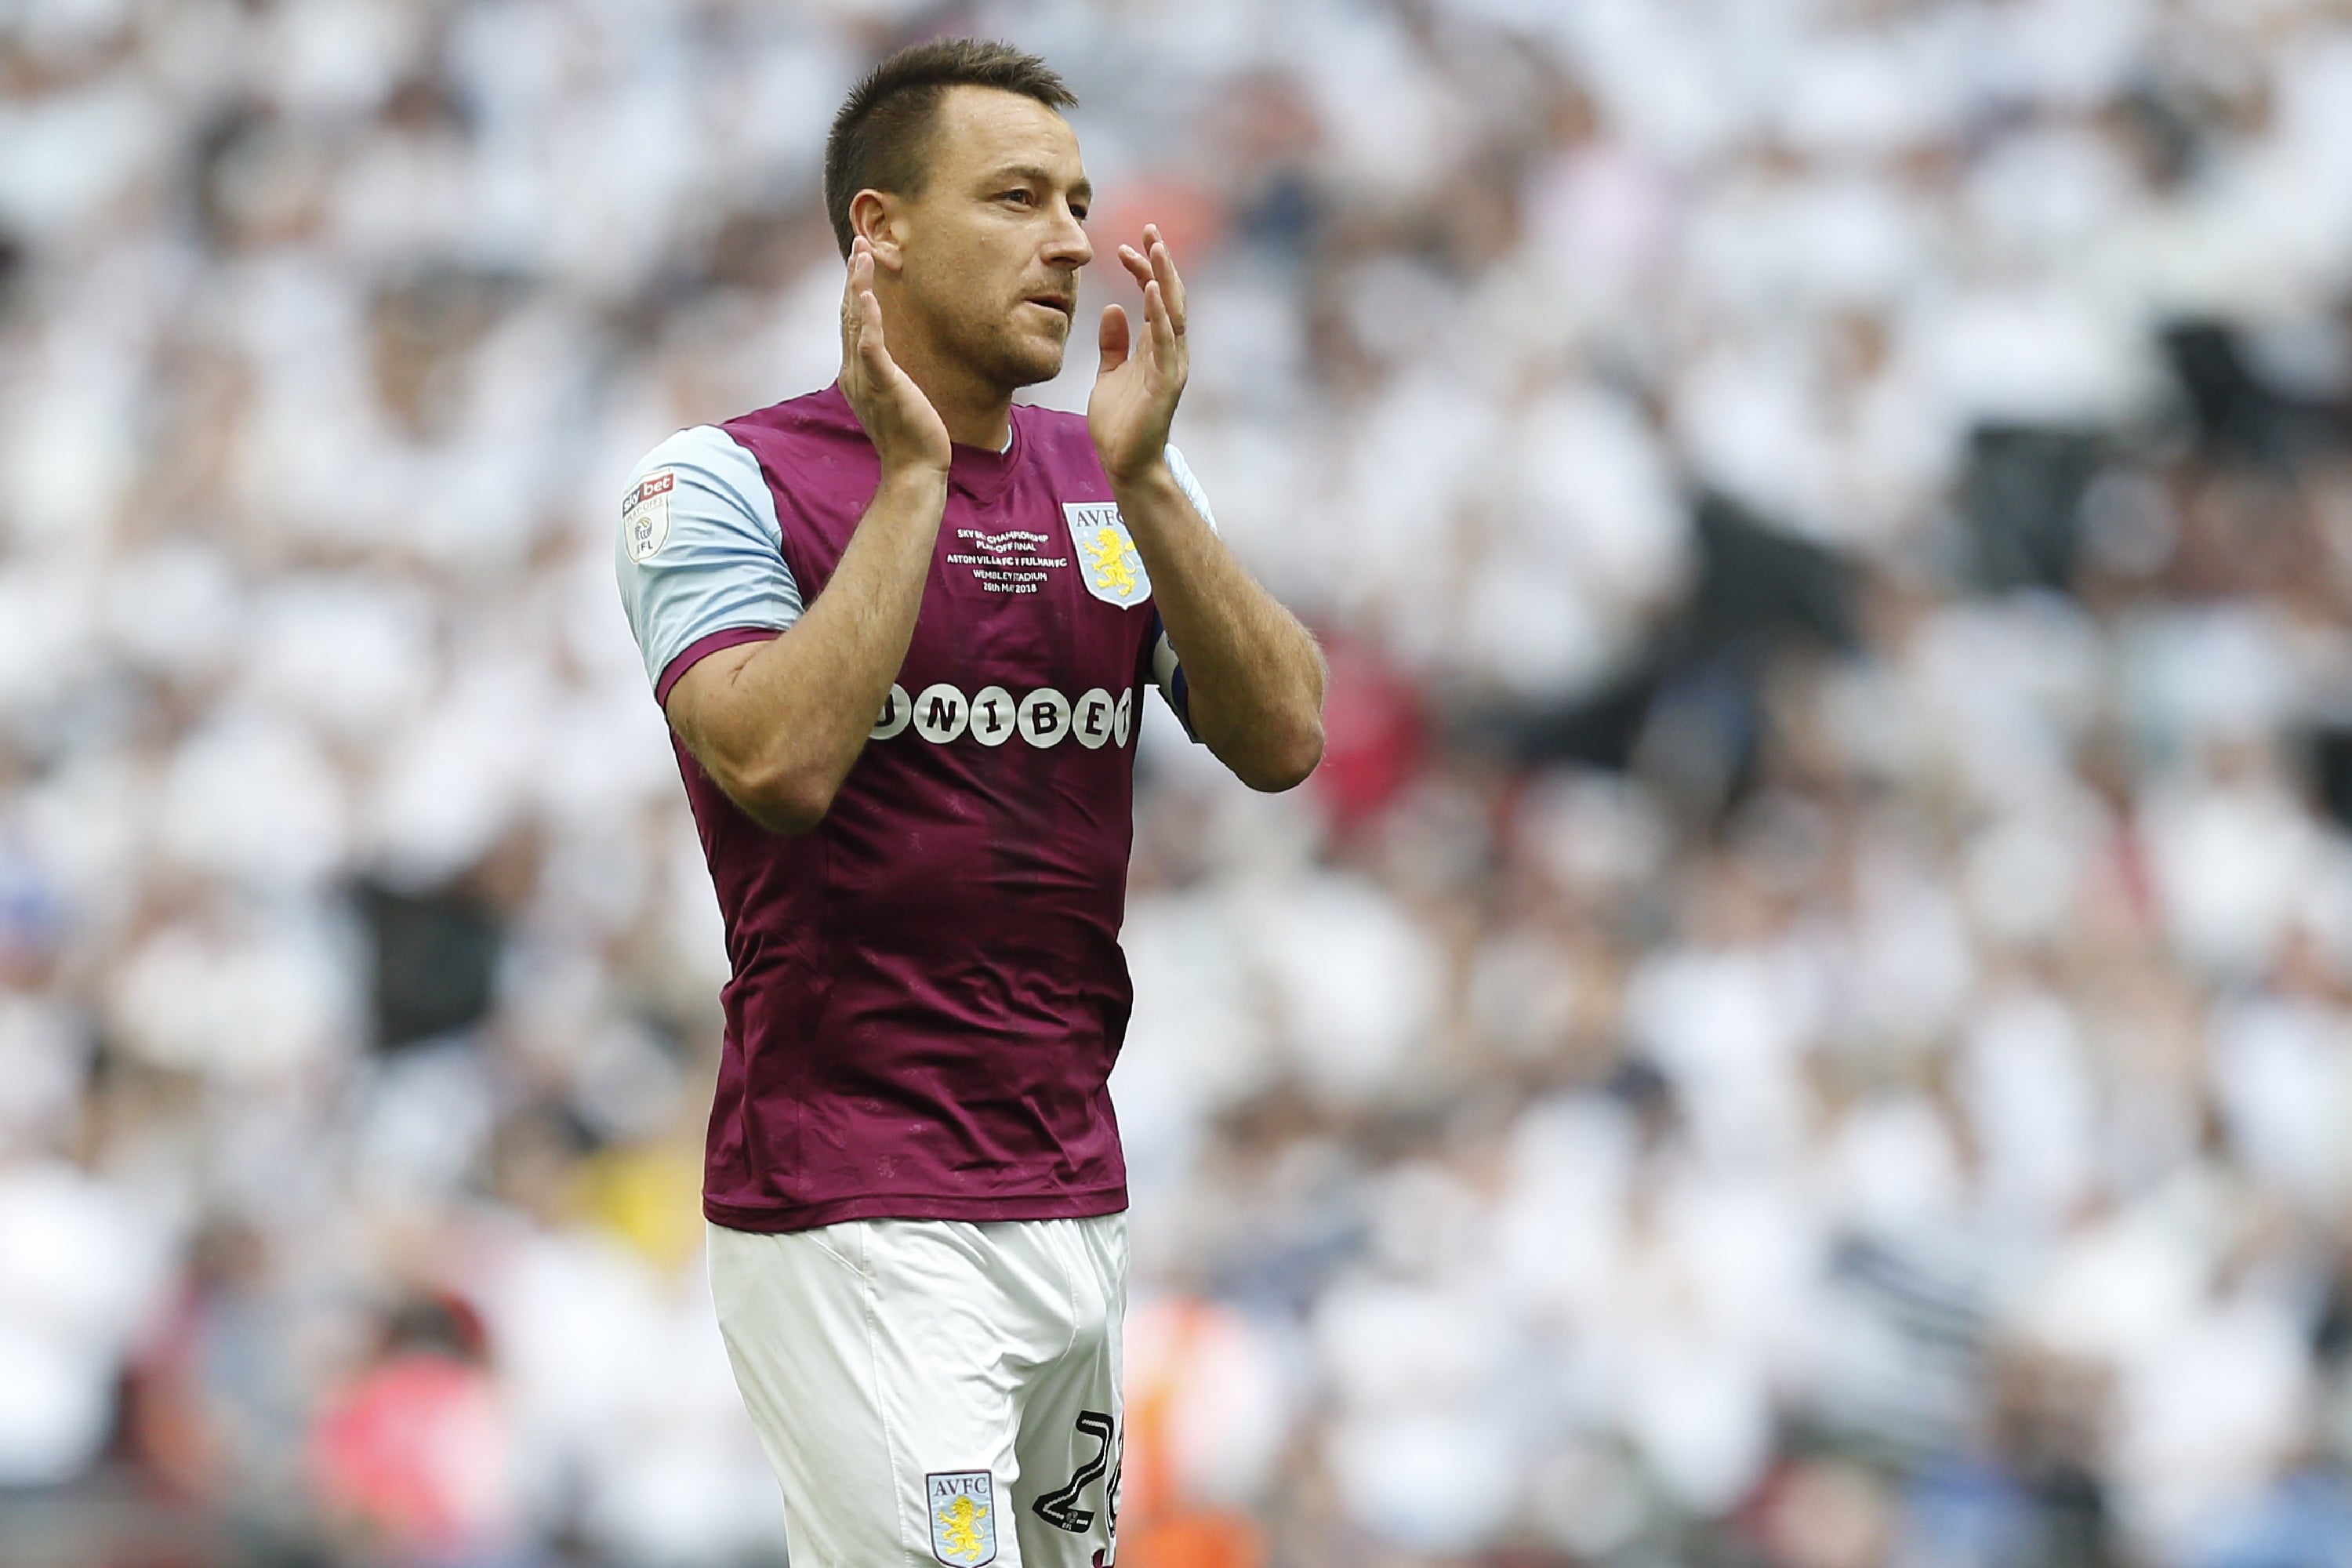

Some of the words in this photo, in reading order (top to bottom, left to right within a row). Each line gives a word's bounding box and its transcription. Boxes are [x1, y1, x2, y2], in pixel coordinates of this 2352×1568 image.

[624, 489, 641, 513] sky
[643, 477, 670, 496] bet
[957, 528, 974, 538] SKY
[947, 554, 976, 564] ASTON
[977, 555, 1002, 565] VILLA
[973, 568, 1013, 580] WEMBLEY
[1015, 583, 1038, 593] 2018
[934, 1477, 987, 1497] AVFC
